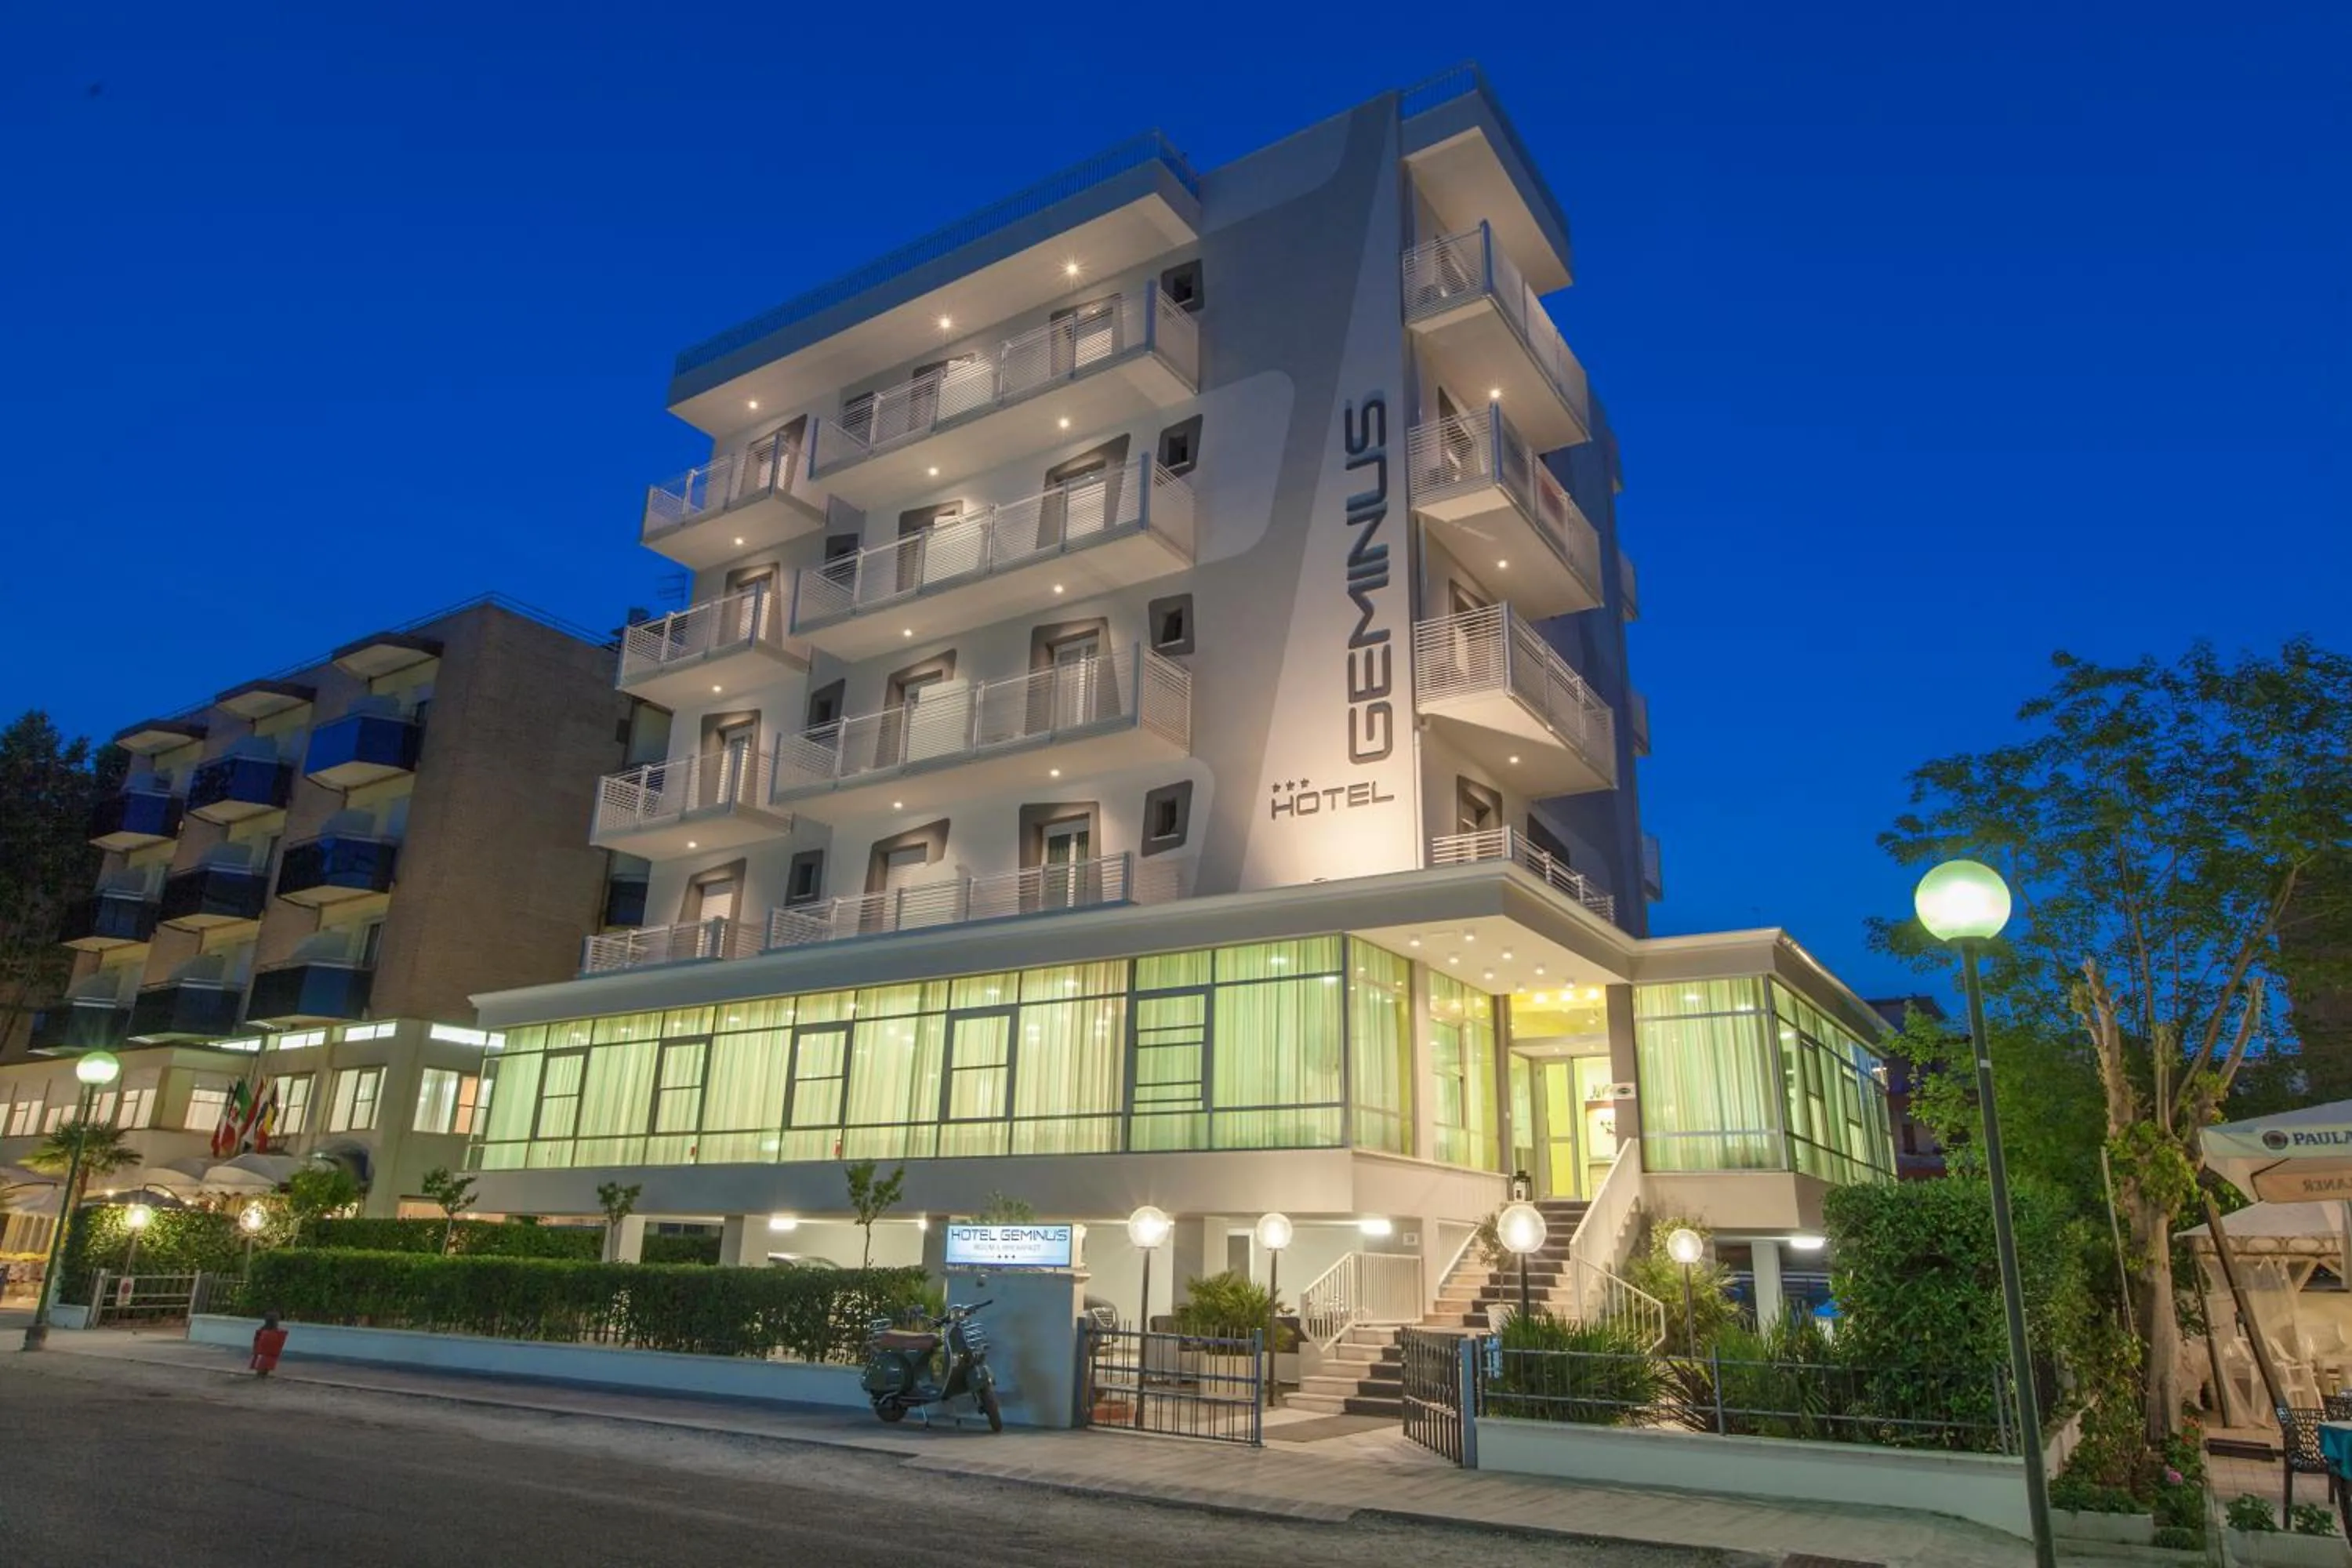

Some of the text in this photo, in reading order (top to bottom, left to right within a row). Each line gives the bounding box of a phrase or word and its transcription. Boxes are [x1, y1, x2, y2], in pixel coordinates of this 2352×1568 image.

[1345, 390, 1394, 765] GEMINUS
[1271, 780, 1395, 820] HOTEL
[951, 1229, 1068, 1242] HOTEL GEMINUS
